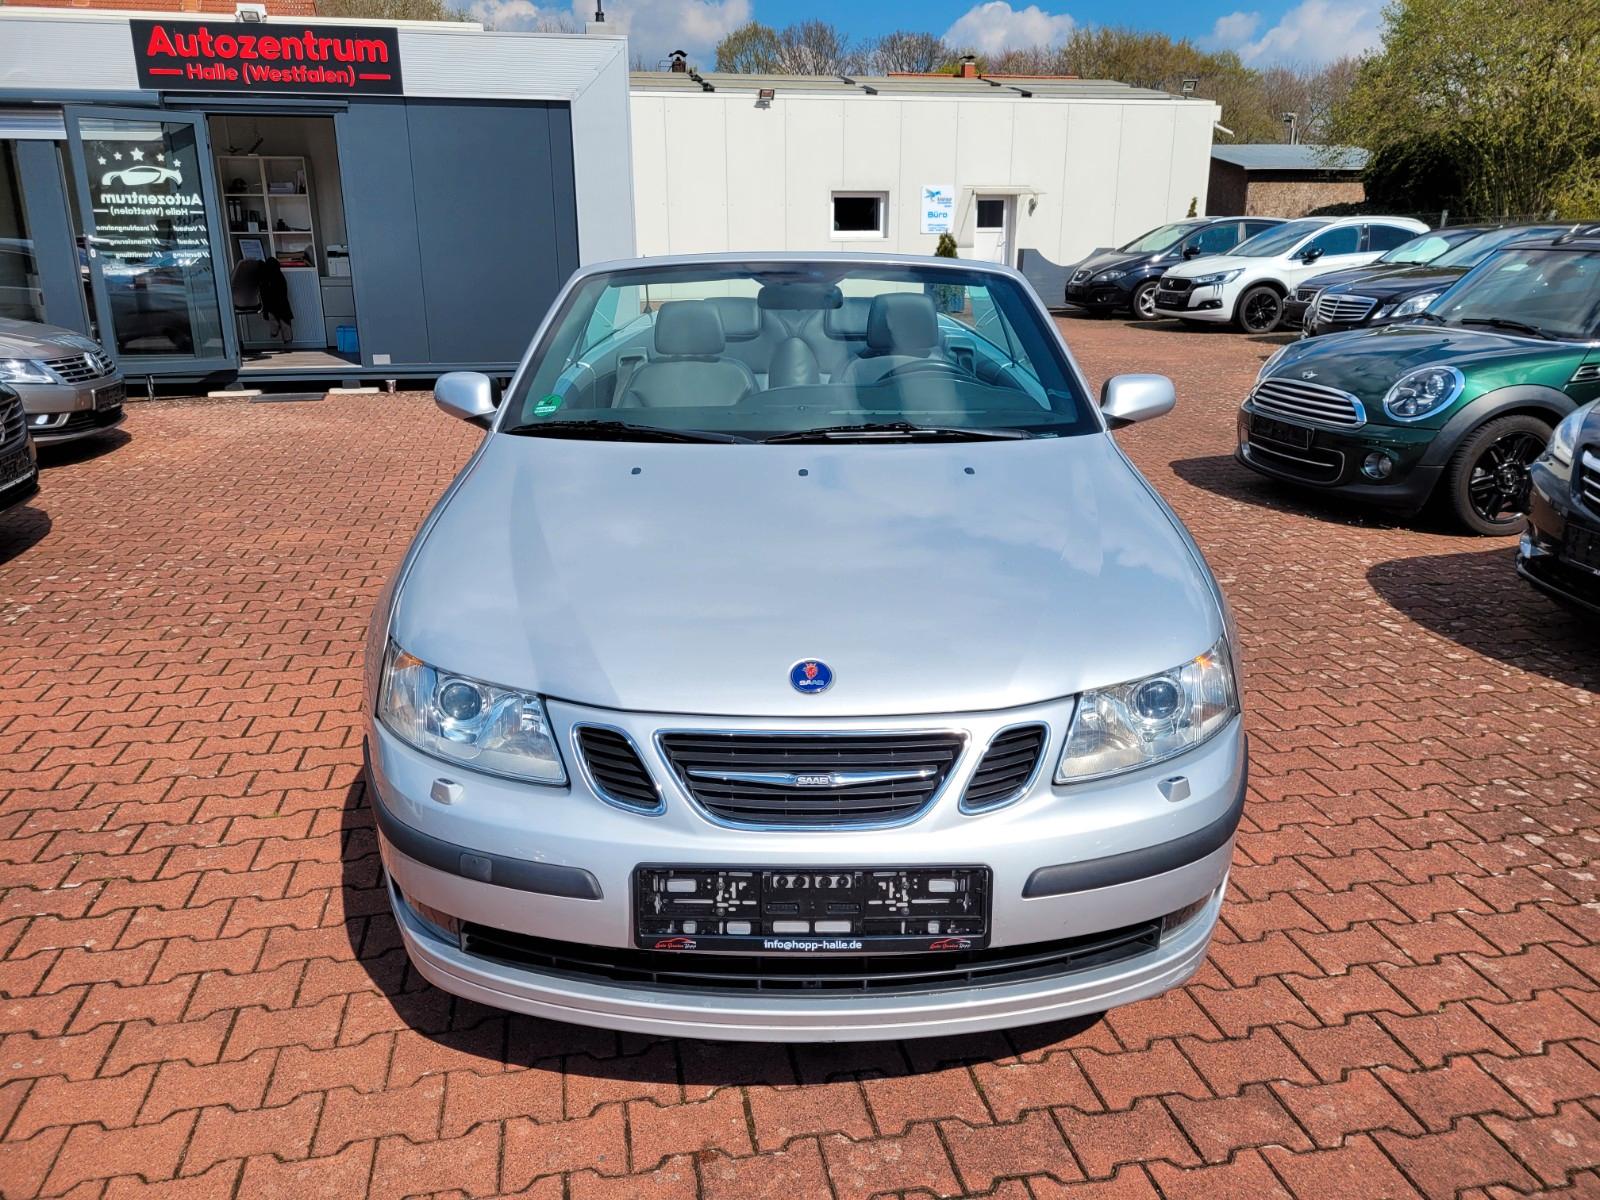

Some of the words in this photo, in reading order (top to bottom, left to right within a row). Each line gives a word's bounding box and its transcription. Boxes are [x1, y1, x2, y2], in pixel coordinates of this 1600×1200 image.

[147, 25, 388, 62] Autozentrum
[186, 63, 238, 80] Halle
[242, 63, 355, 87] (Westfalen)
[797, 776, 829, 785] SAAB
[763, 939, 862, 951] info@hopp-halle.de
